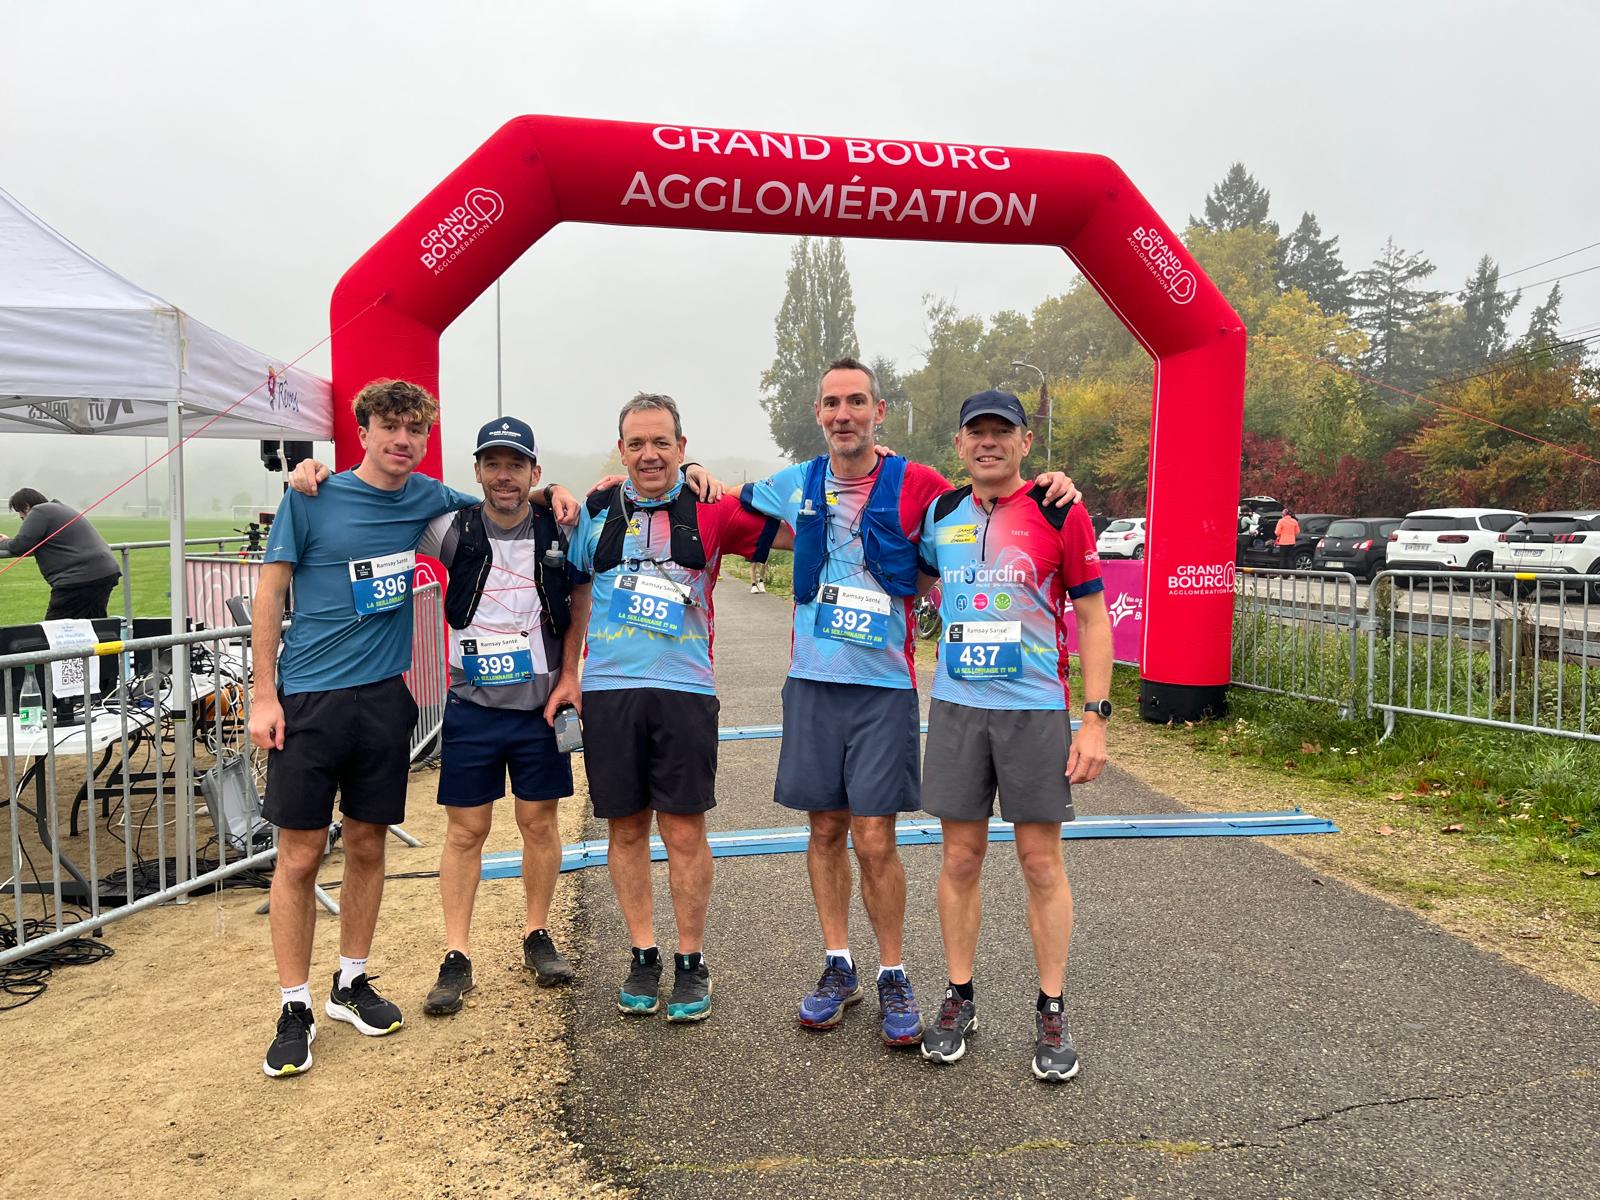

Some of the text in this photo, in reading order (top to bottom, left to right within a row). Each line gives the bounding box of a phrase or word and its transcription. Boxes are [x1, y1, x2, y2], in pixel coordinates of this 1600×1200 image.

[652, 126, 1012, 172] GRAND BOURG
[620, 170, 1038, 227] AGGLOMÉRATION
[420, 206, 467, 249] GRAND
[420, 214, 478, 270] BOURG
[433, 223, 490, 276] AGGLOMÉRATION
[1132, 226, 1176, 280] BOURG
[1148, 228, 1182, 270] GRAND
[1126, 237, 1169, 290] AGGLOMÉRATION
[377, 560, 396, 569] Ramsay
[1176, 564, 1224, 576] GRAND
[372, 575, 407, 599] 396
[641, 580, 662, 591] Ramsay
[1168, 575, 1224, 589] BOURG
[1168, 588, 1227, 596] AGGLOMÉRATION
[628, 595, 669, 620] 395
[842, 592, 865, 602] Ramsay
[831, 608, 872, 633] 392
[477, 655, 515, 675] 399
[960, 645, 1001, 666] 437
